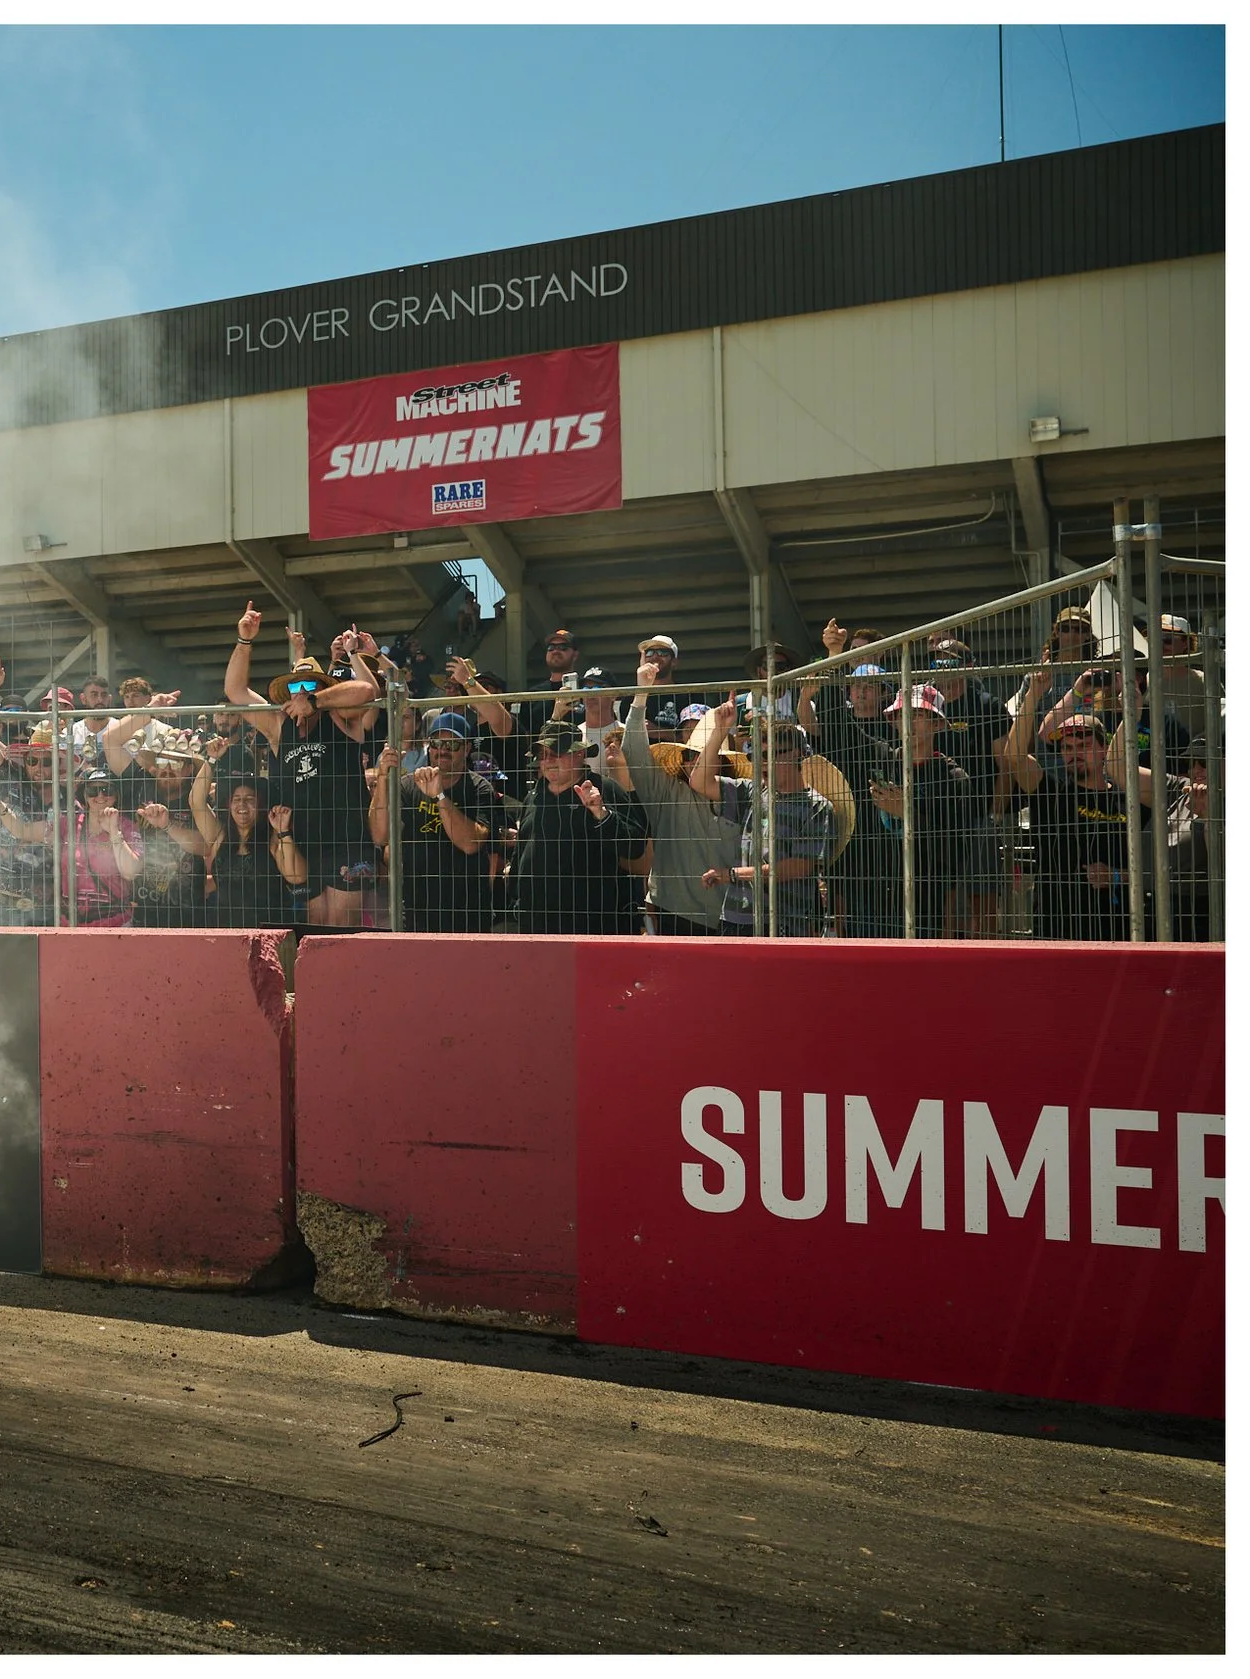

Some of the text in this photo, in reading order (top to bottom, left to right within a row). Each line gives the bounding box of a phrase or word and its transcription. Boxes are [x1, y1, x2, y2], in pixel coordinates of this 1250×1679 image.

[226, 263, 628, 355] PLOVER GRANDSTAND
[396, 380, 521, 422] MACHINE
[412, 372, 511, 404] Street
[321, 411, 607, 482] SUMMERNATS
[434, 481, 484, 502] RARE
[435, 500, 483, 511] SPARES
[681, 1086, 1225, 1254] SUMMER
